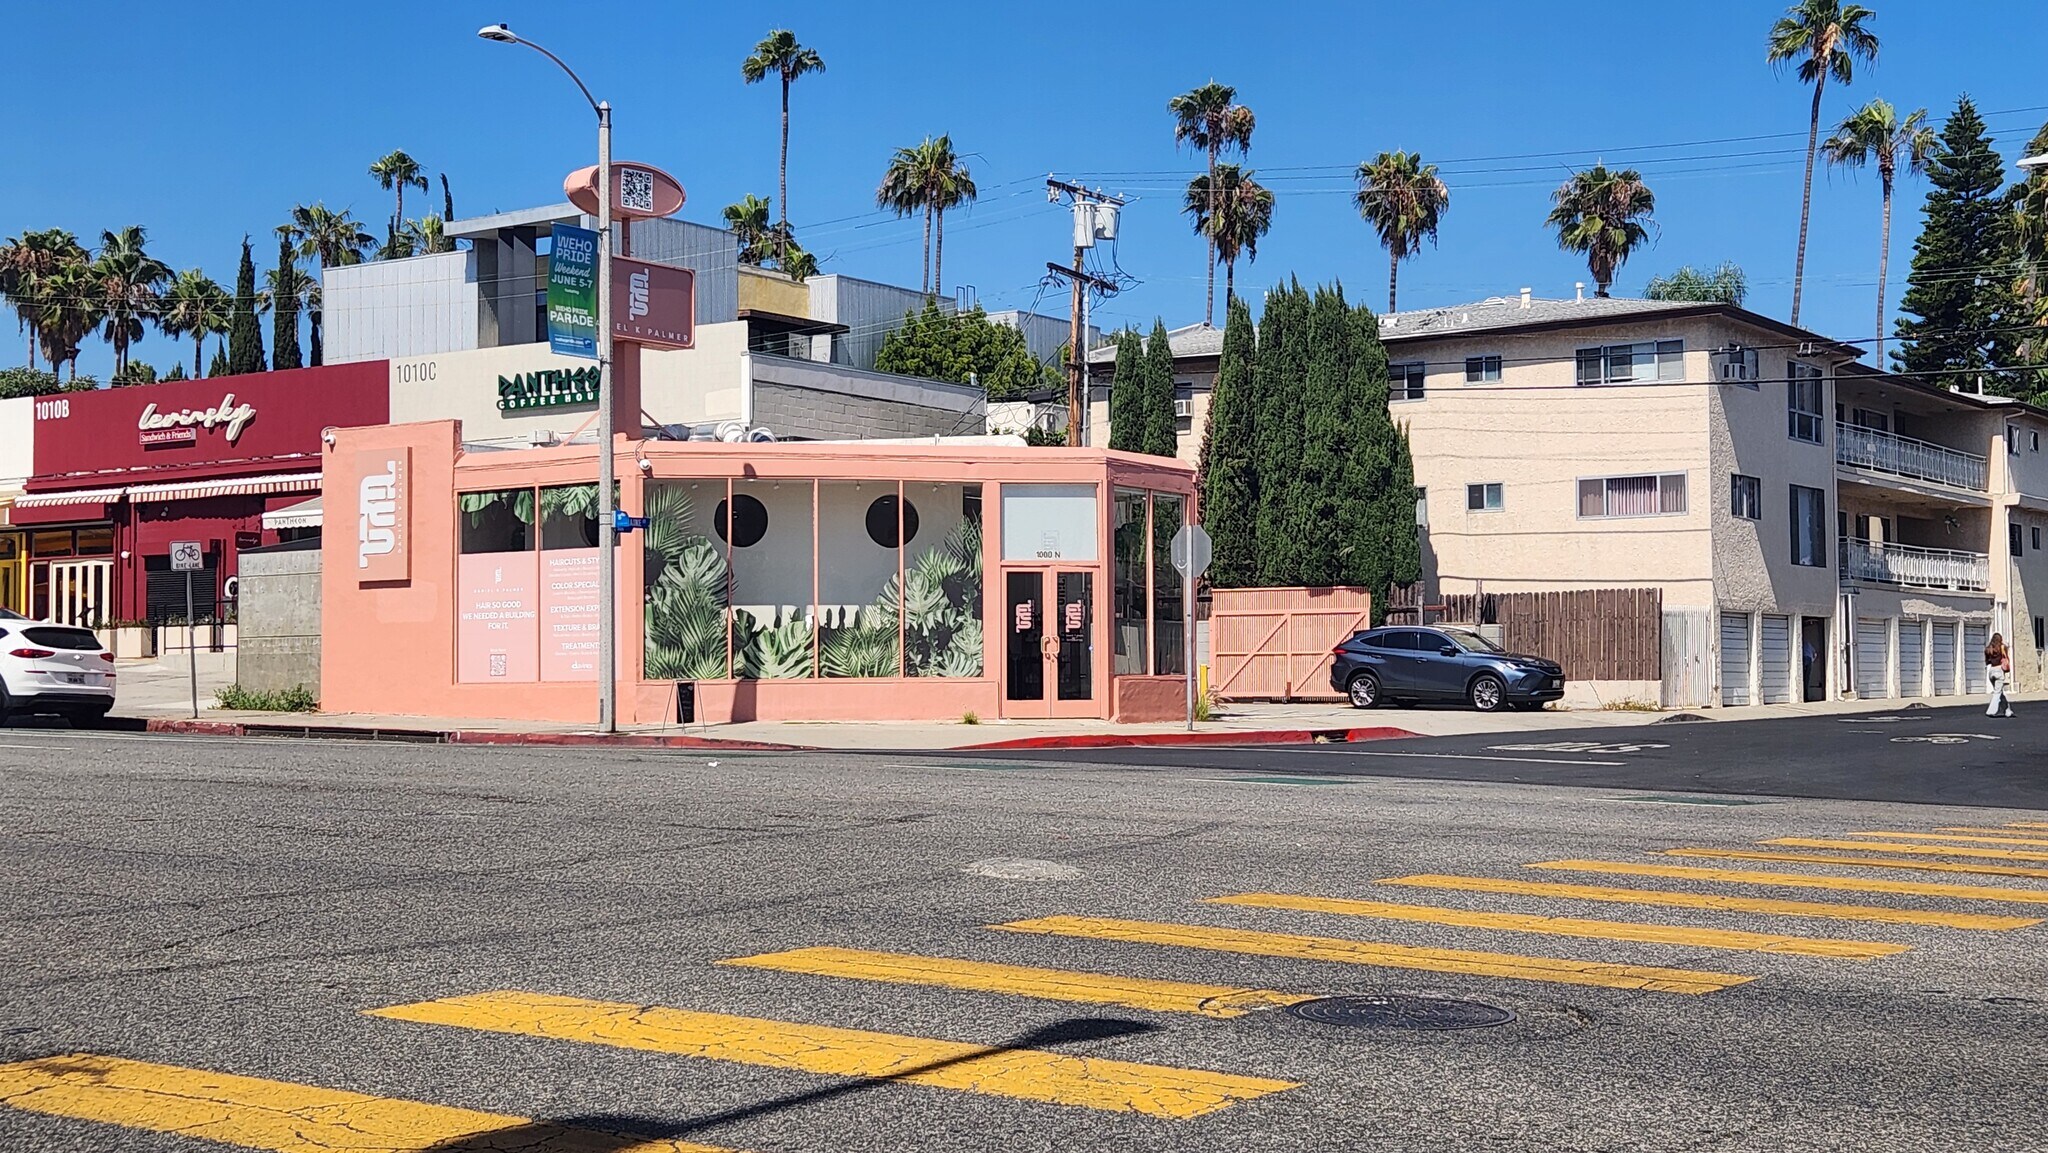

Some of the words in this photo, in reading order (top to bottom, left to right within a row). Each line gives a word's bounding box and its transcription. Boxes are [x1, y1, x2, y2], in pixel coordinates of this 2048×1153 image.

[557, 234, 592, 252] WEHO
[556, 248, 591, 264] PRIDE
[554, 262, 591, 277] Weekend
[551, 274, 577, 286] JUNE
[579, 278, 593, 288] 5-7
[550, 310, 594, 327] PARADE
[616, 322, 628, 332] EL
[635, 326, 641, 334] K
[647, 328, 688, 342] PALMER
[396, 361, 437, 383] 1010C
[498, 365, 600, 397] PANTHEO
[498, 396, 556, 410] COFFEE
[564, 391, 600, 403] HOU
[35, 399, 70, 420] 1010B
[587, 556, 600, 565] STY
[1054, 550, 1061, 559] N
[574, 580, 600, 589] SPECIAL
[501, 600, 521, 608] GOOD
[462, 612, 473, 620] WE
[473, 611, 498, 620] NEEDED
[587, 623, 600, 631] BRA
[561, 641, 600, 650] TREATMENT
